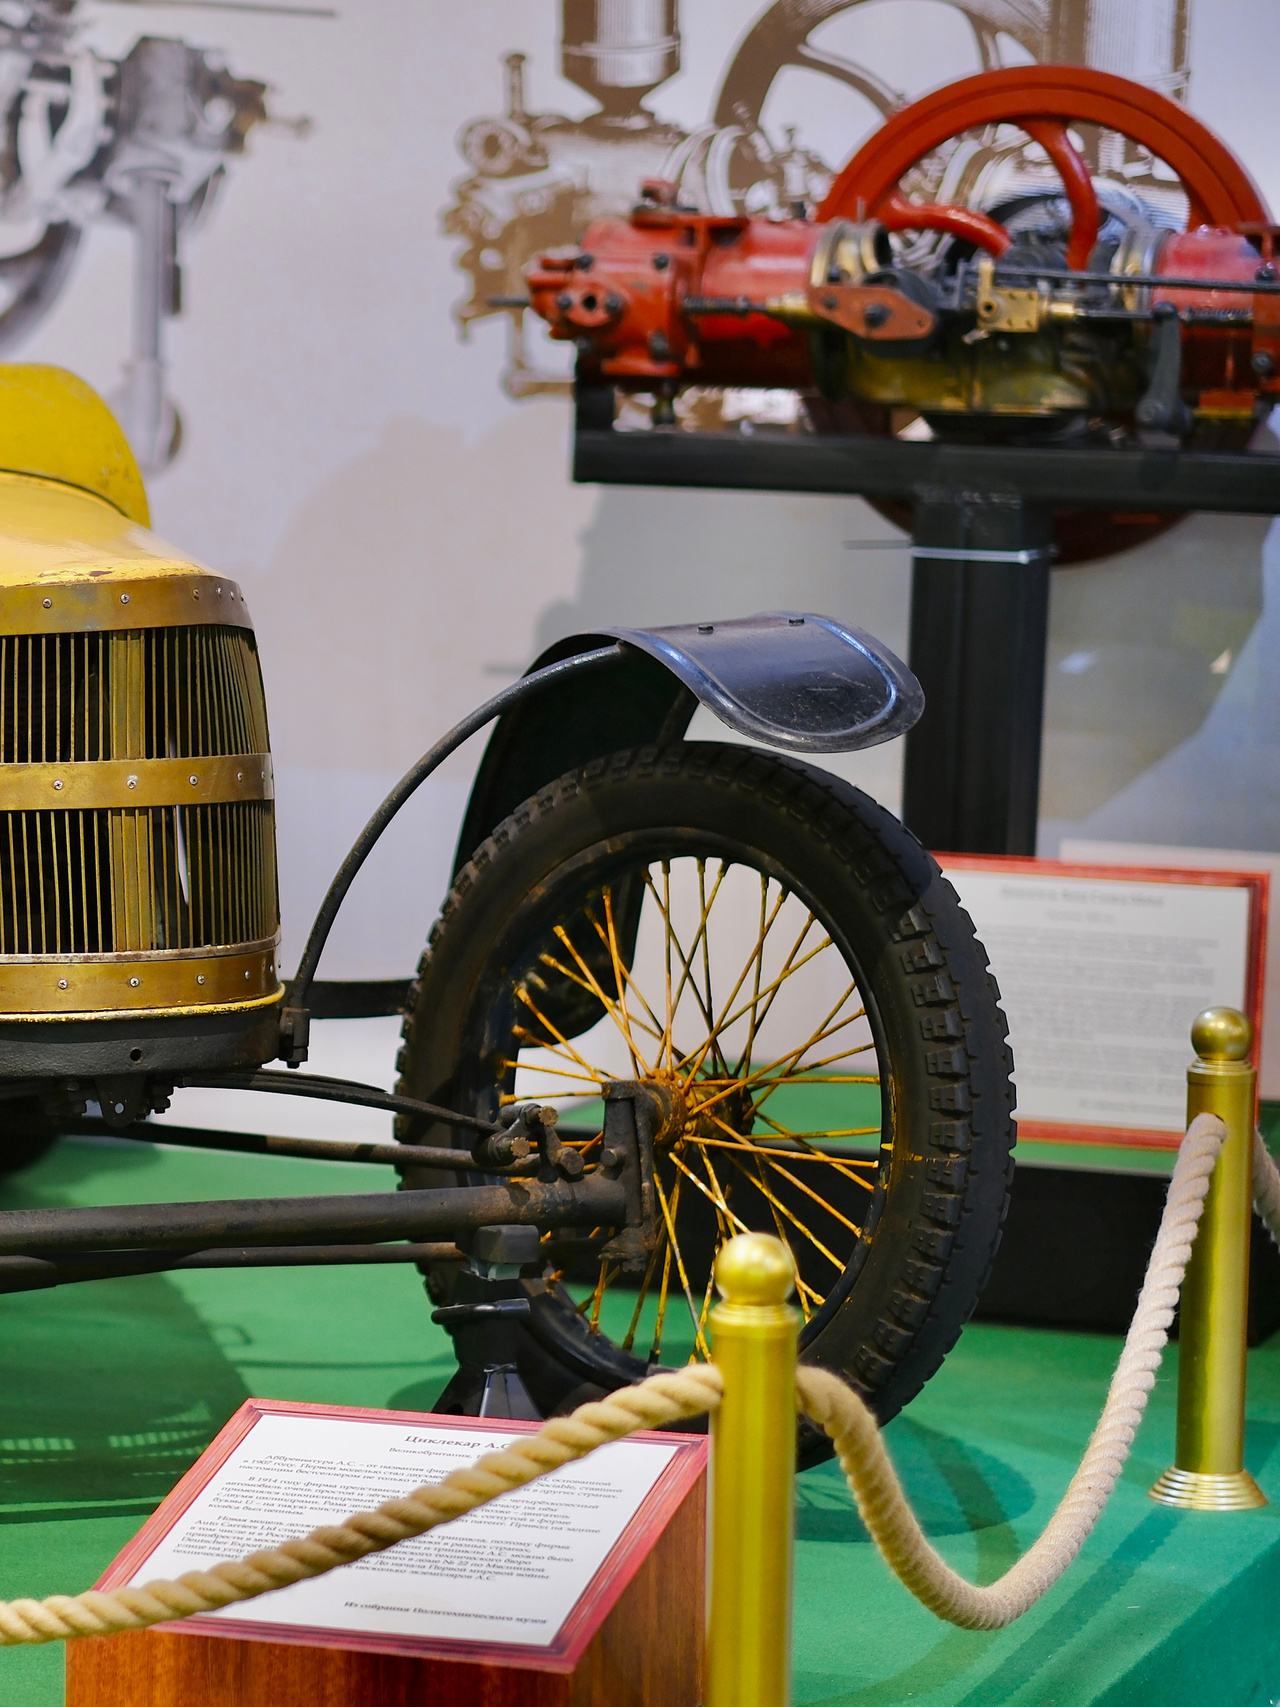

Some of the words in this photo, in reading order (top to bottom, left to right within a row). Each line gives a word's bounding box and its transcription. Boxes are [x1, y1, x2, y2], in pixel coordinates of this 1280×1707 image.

[388, 1447, 471, 1459] Великобритания,
[404, 1435, 482, 1449] Циклекар
[238, 1464, 294, 1473] настоящим
[295, 1468, 362, 1479] бестселлером
[264, 1454, 334, 1466] Аббревиатура
[379, 1464, 425, 1472] названия
[551, 1478, 612, 1487] основанной
[299, 1463, 337, 1471] Первой
[338, 1467, 382, 1475] моделью
[536, 1482, 576, 1490] Sociable,
[225, 1481, 282, 1490] автомобиль
[314, 1488, 355, 1496] простой
[303, 1481, 338, 1489] фирма
[339, 1485, 401, 1494] представила
[220, 1486, 281, 1496] применялся
[281, 1492, 375, 1504] одноцилиндровый
[519, 1511, 570, 1519] двигатель
[255, 1495, 320, 1505] цилиндрами.
[480, 1514, 527, 1522] согнутой
[536, 1517, 572, 1525] форме
[263, 1508, 304, 1516] цепным.
[309, 1506, 354, 1514] конструк
[509, 1521, 549, 1530] Привод
[217, 1515, 248, 1523] Новая
[437, 1535, 488, 1544] трицикла,
[490, 1539, 533, 1547] поэтому
[534, 1542, 570, 1550] фирма
[220, 1521, 259, 1530] Carriers
[450, 1542, 487, 1550] разных
[181, 1536, 229, 1546] Deutscher
[230, 1540, 263, 1549] Export
[485, 1562, 545, 1573] Мясницкой
[185, 1531, 244, 1541] приобрести
[434, 1553, 502, 1563] технического
[503, 1558, 532, 1566] бюро
[433, 1547, 485, 1556] трициклы
[172, 1549, 241, 1559] техническому
[355, 1565, 407, 1574] несколько
[410, 1570, 473, 1579] экземпляров
[428, 1564, 467, 1573] Первой
[468, 1568, 514, 1577] мировой
[515, 1572, 549, 1580] войны
[360, 1603, 410, 1613] собрания
[412, 1607, 514, 1621] Политехнического
[515, 1617, 547, 1625] музея
